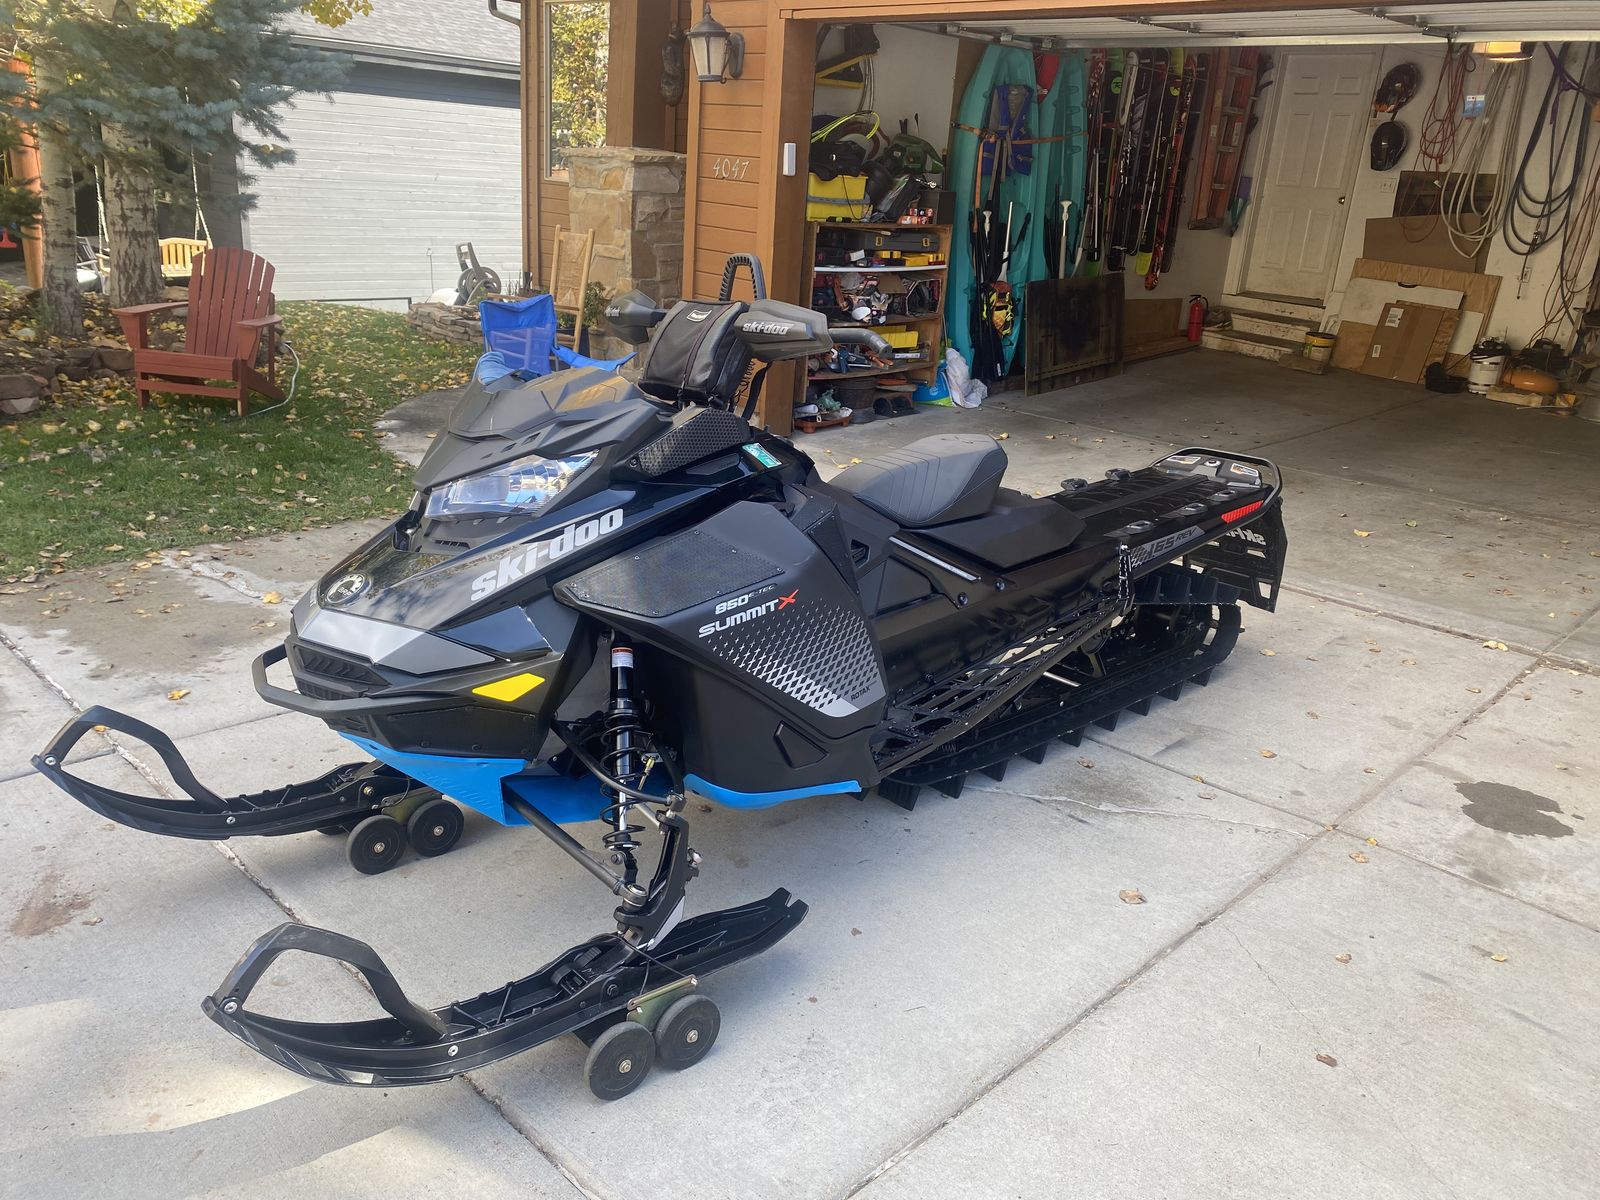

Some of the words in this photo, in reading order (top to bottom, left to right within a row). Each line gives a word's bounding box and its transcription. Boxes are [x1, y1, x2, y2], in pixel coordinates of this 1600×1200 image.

[713, 158, 749, 180] 4047
[742, 321, 788, 336] ski-doo
[471, 508, 624, 602] ski-doo
[1149, 536, 1175, 559] 165
[1175, 527, 1198, 542] REV
[698, 598, 779, 639] SUMMIT
[777, 588, 800, 610] X
[715, 594, 749, 615] 850
[748, 585, 776, 598] E-TEC
[850, 685, 871, 702] ROTAX
